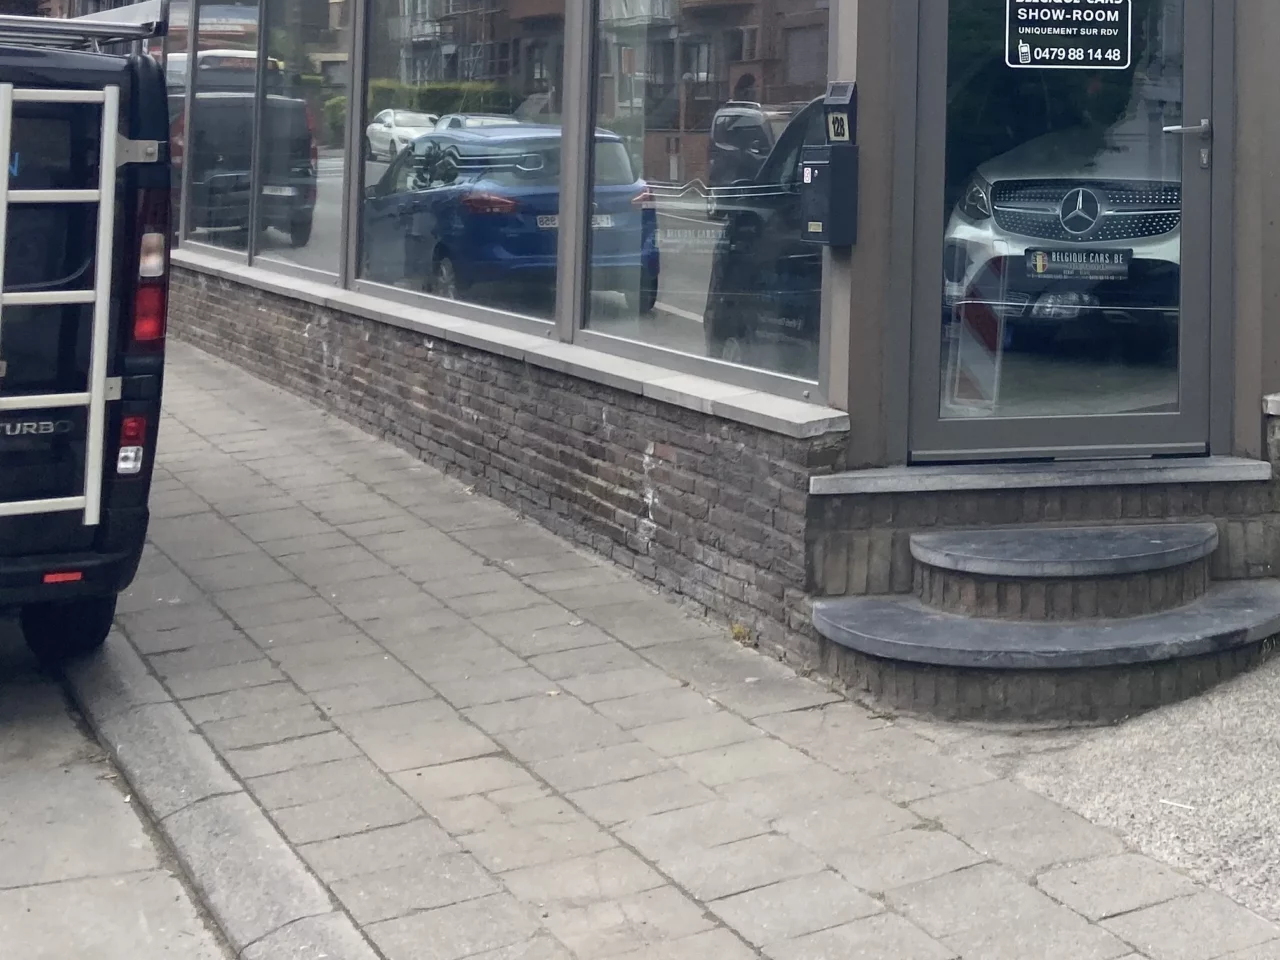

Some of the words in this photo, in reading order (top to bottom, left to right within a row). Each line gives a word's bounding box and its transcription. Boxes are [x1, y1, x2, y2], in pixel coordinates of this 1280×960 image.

[1017, 8, 1119, 22] SHOW-ROOM
[1018, 27, 1078, 35] UNIQUEMENT
[1080, 28, 1098, 36] SUR
[1100, 28, 1119, 36] RDV
[1034, 47, 1066, 60] 0479
[1067, 48, 1085, 60] 88
[1087, 48, 1103, 61] 14
[1104, 48, 1121, 61] 48
[832, 116, 845, 138] 128
[1051, 251, 1087, 263] BELGIQUE
